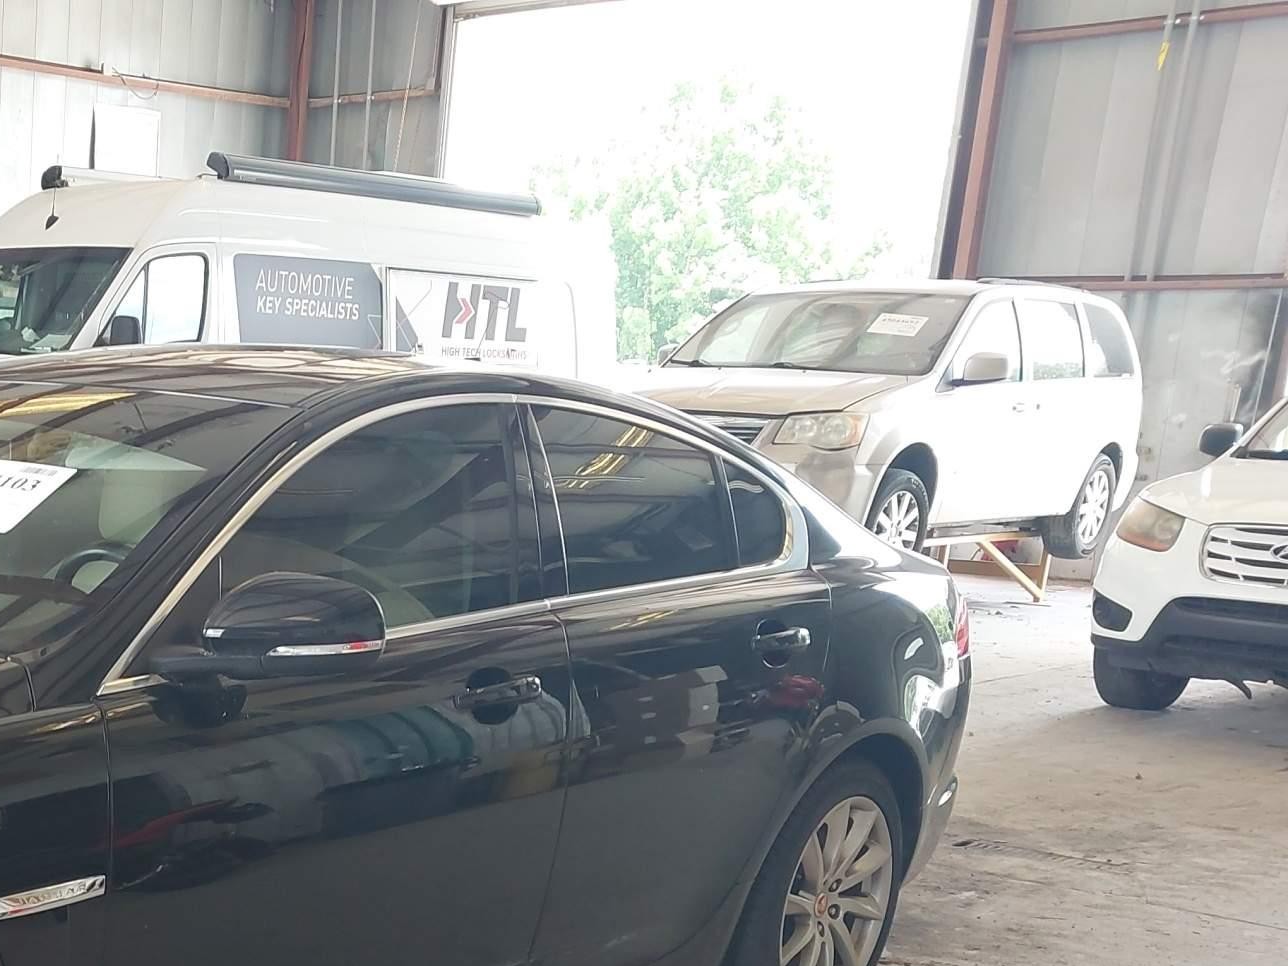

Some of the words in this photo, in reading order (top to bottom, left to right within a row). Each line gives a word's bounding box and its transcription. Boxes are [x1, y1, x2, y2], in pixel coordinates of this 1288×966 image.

[255, 268, 355, 299] AUTOMOTIVE
[256, 295, 282, 315] KEY
[284, 297, 360, 321] SPECIALISTS
[441, 281, 528, 342] HTL
[441, 346, 460, 357] HIGH
[462, 347, 481, 358] TECH
